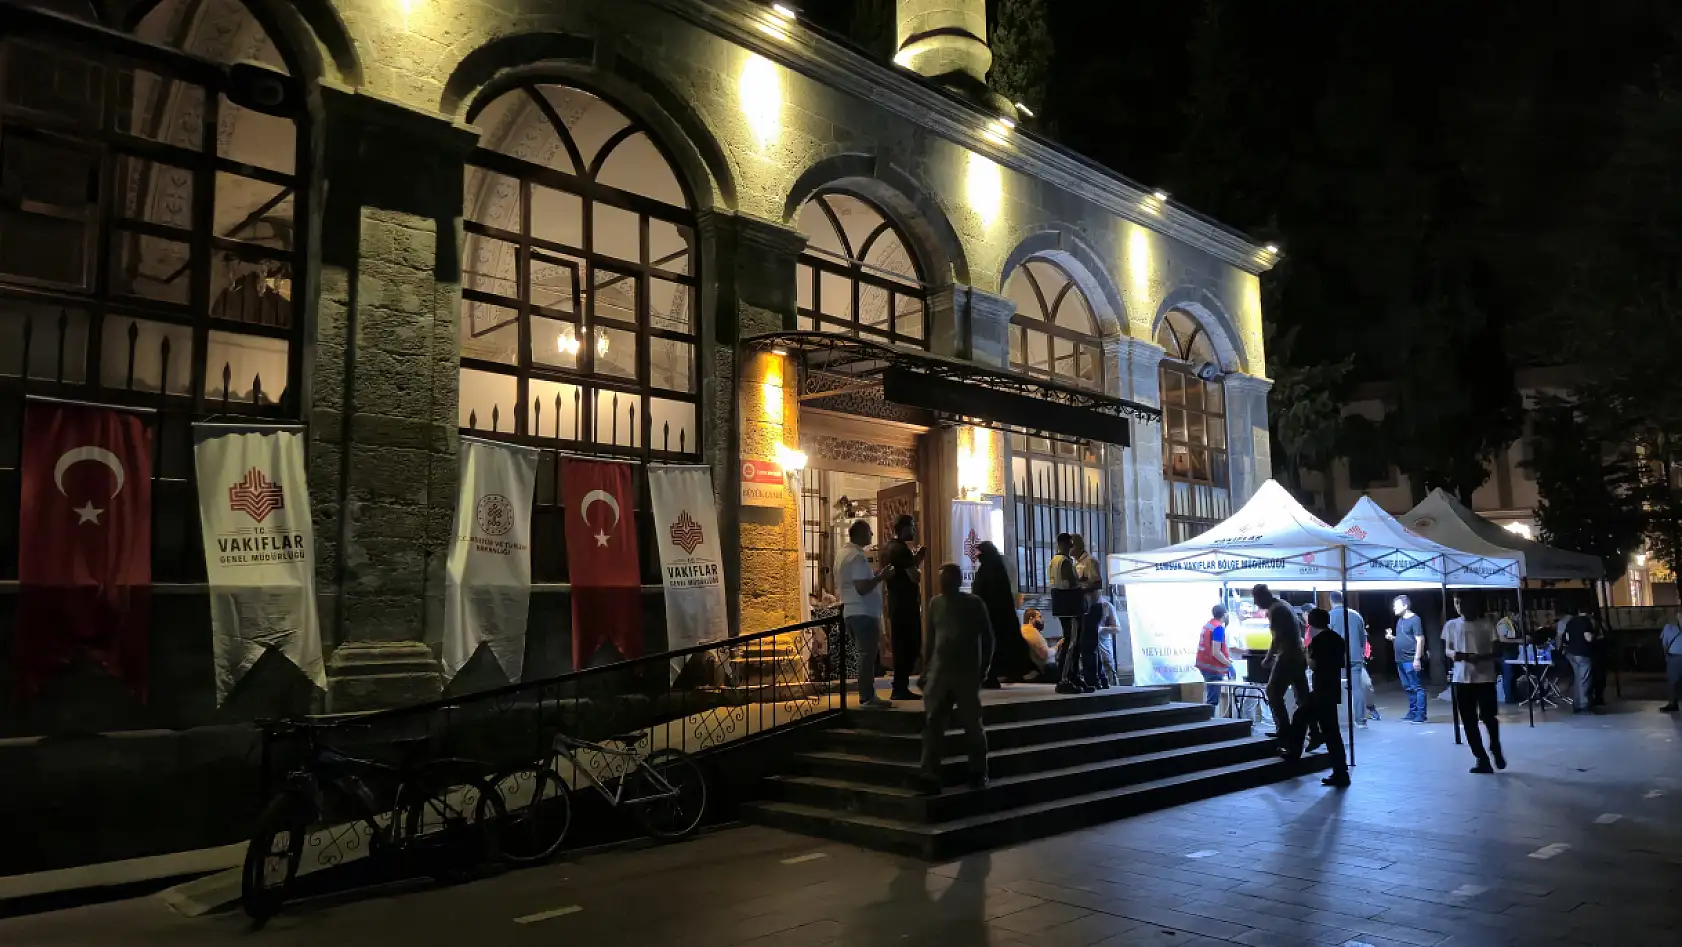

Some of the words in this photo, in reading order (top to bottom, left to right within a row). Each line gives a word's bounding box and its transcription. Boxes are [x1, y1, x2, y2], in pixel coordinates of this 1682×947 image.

[217, 535, 304, 552] VAKIFLAR
[219, 554, 248, 563] GENEL
[1183, 560, 1216, 571] VAKIFLAR
[1217, 558, 1240, 570] BÖLGE
[667, 564, 718, 577] VAKIFLAR
